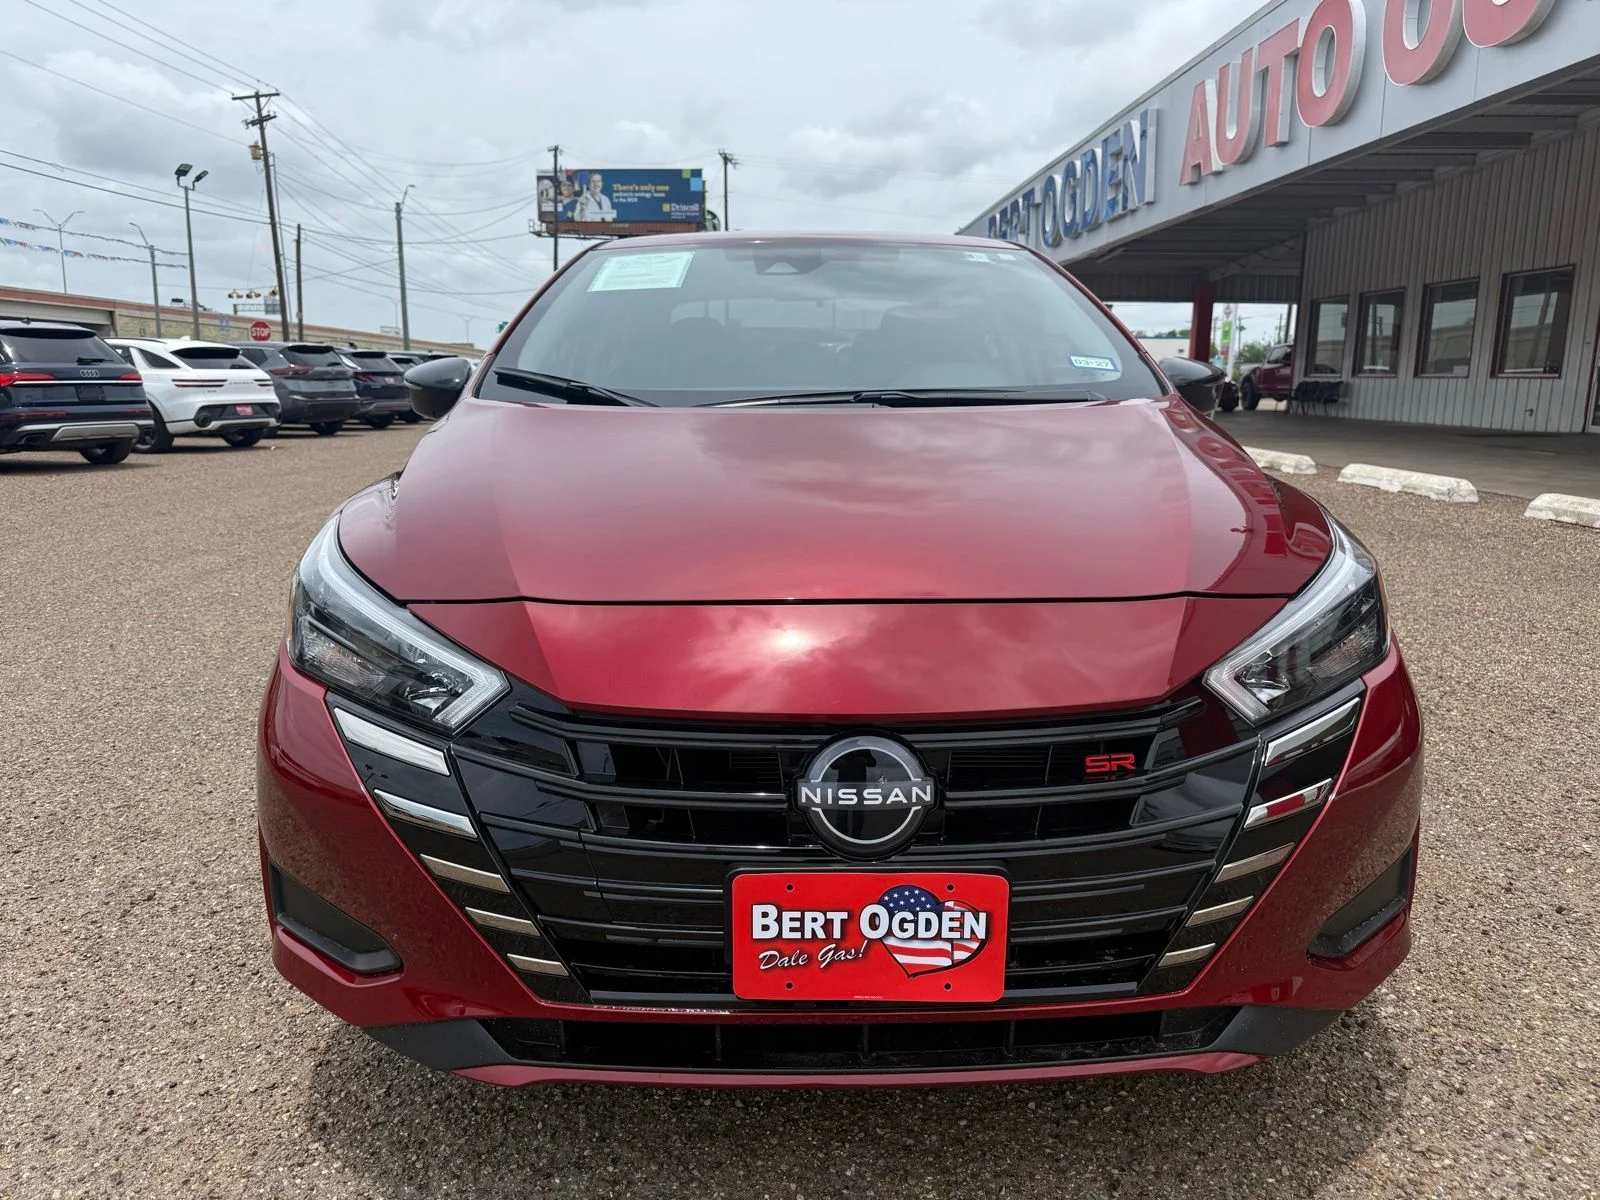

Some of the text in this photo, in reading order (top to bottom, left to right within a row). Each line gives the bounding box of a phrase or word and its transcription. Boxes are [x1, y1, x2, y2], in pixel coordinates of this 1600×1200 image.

[1041, 108, 1157, 248] OGDEN
[1179, 0, 1366, 187] AUTO
[640, 183, 655, 192] only
[671, 203, 700, 211] Driscoll
[251, 327, 270, 336] STOP
[1084, 753, 1136, 773] SR
[801, 785, 931, 805] NISSAN
[752, 903, 987, 940] BERT OGDEN
[758, 939, 868, 970] Dale Gas!
